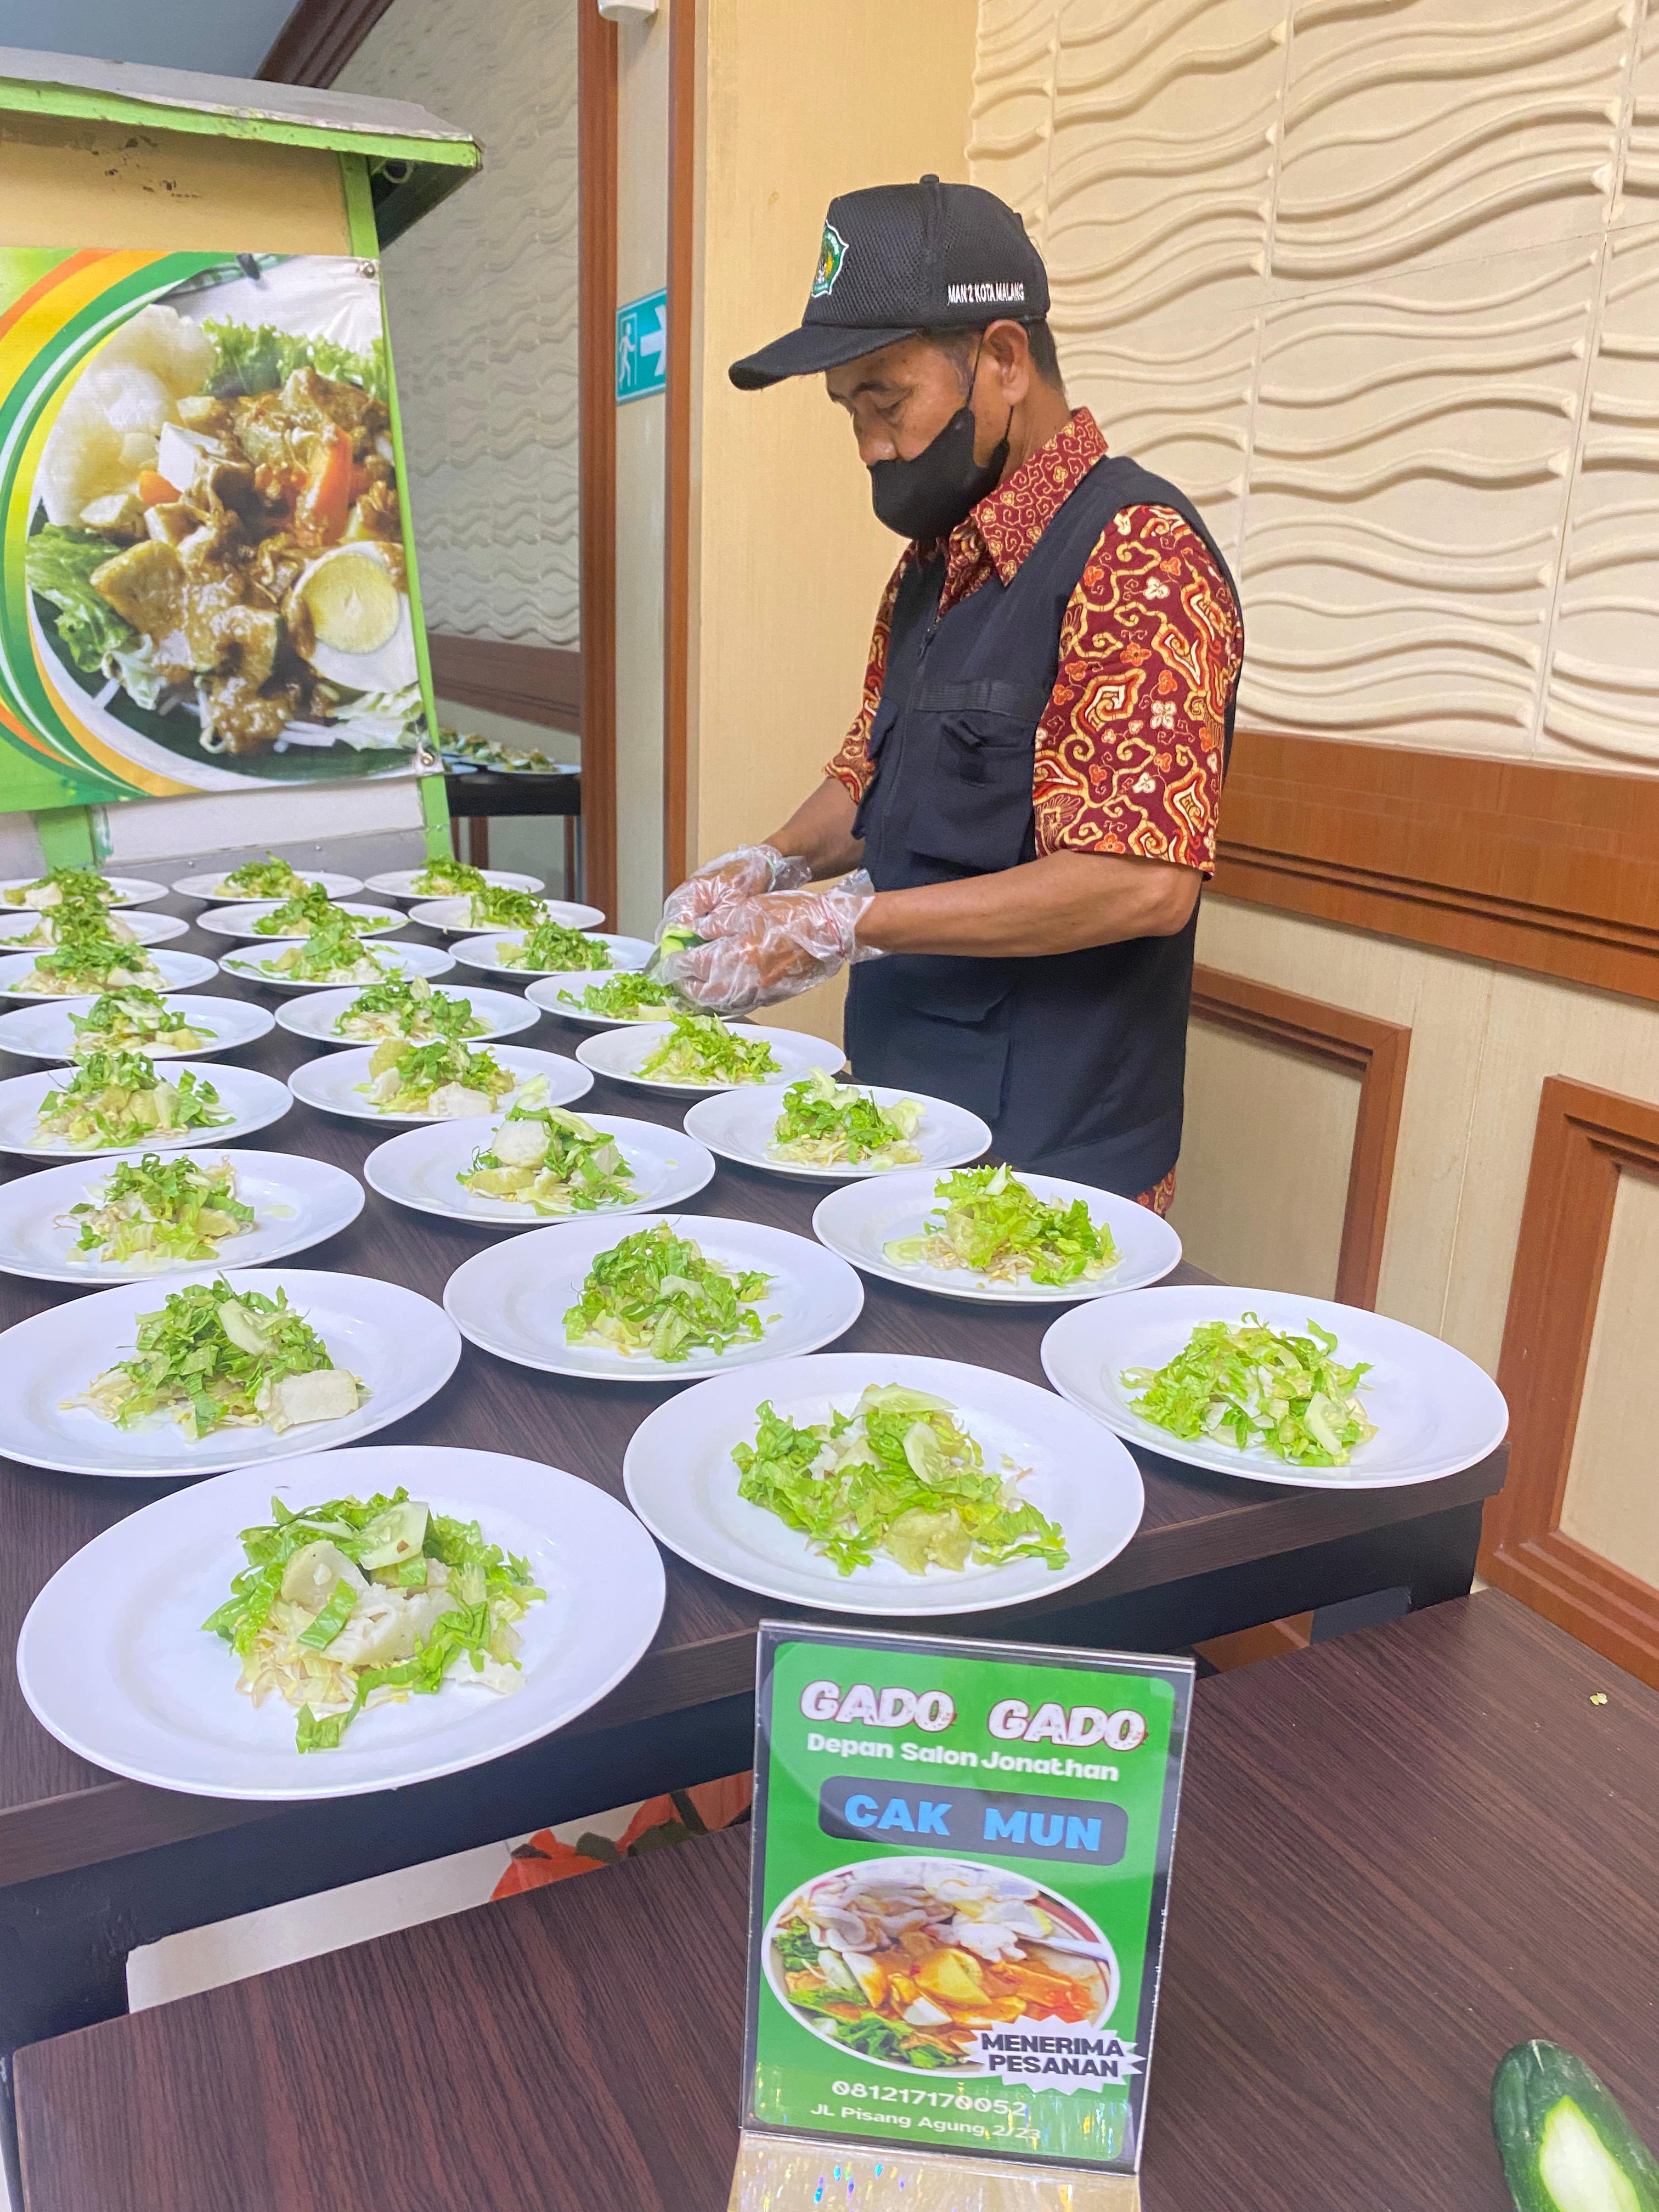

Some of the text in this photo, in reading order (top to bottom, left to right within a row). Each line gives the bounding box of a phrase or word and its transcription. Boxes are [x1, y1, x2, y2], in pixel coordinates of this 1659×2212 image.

[947, 281, 1024, 303] MAN 2 KOTA MALANG
[799, 1679, 1147, 1751] GADO GADO
[807, 1733, 1119, 1782] Depan Salon Jonathan
[844, 1794, 1102, 1852] CAK MUN
[981, 2033, 1124, 2057] MENERIMA
[989, 2054, 1119, 2077] PESANAN
[832, 2081, 1027, 2117] 081217170052
[810, 2104, 834, 2117] JL
[841, 2107, 911, 2128] Pisang
[917, 2117, 985, 2136] Agung
